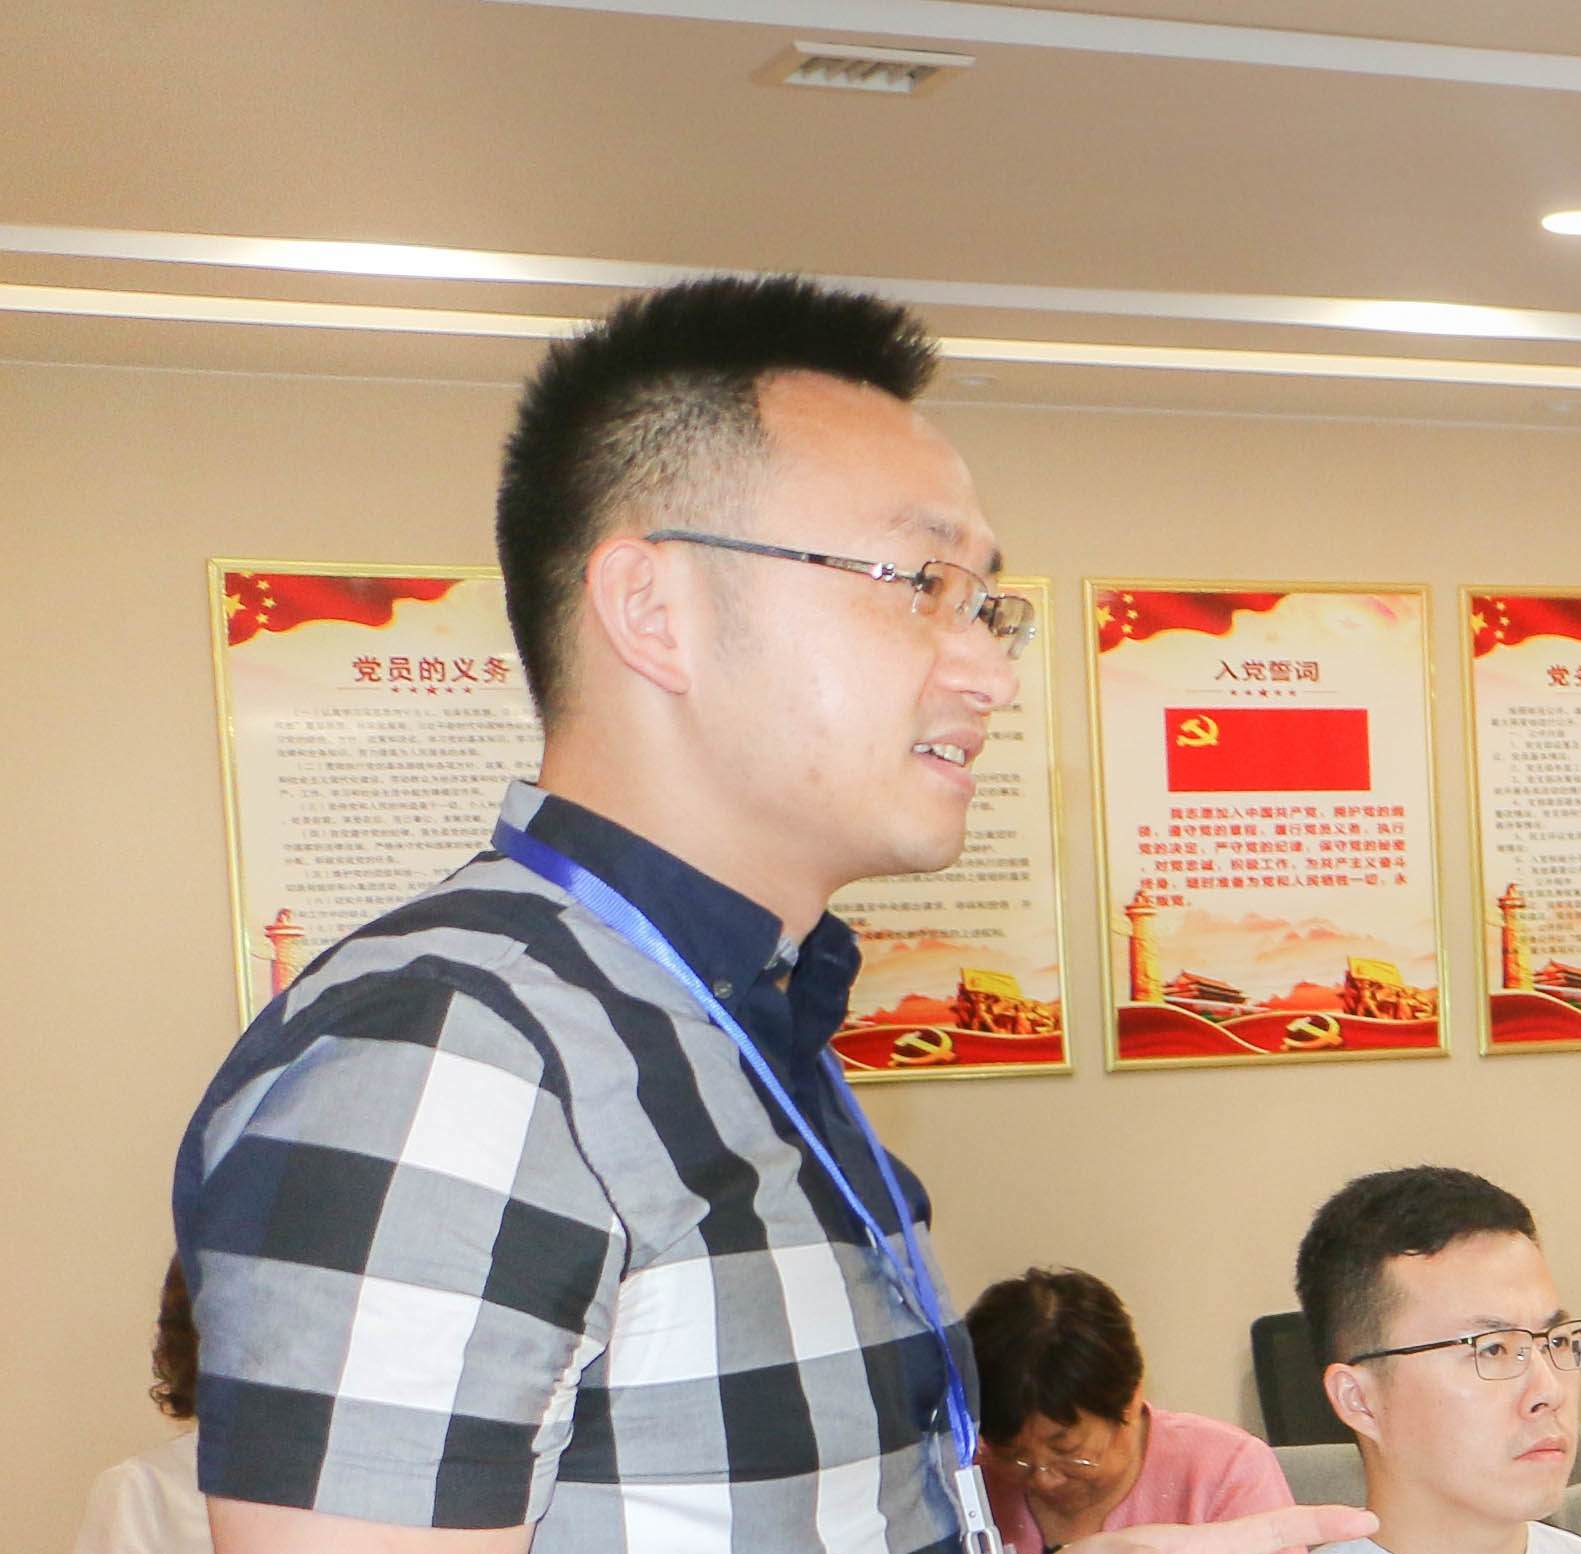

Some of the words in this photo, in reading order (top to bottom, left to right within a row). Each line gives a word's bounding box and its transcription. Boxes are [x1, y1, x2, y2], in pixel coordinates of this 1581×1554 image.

[352, 656, 511, 683] 党员的义务
[1214, 660, 1320, 682] 入党誓词
